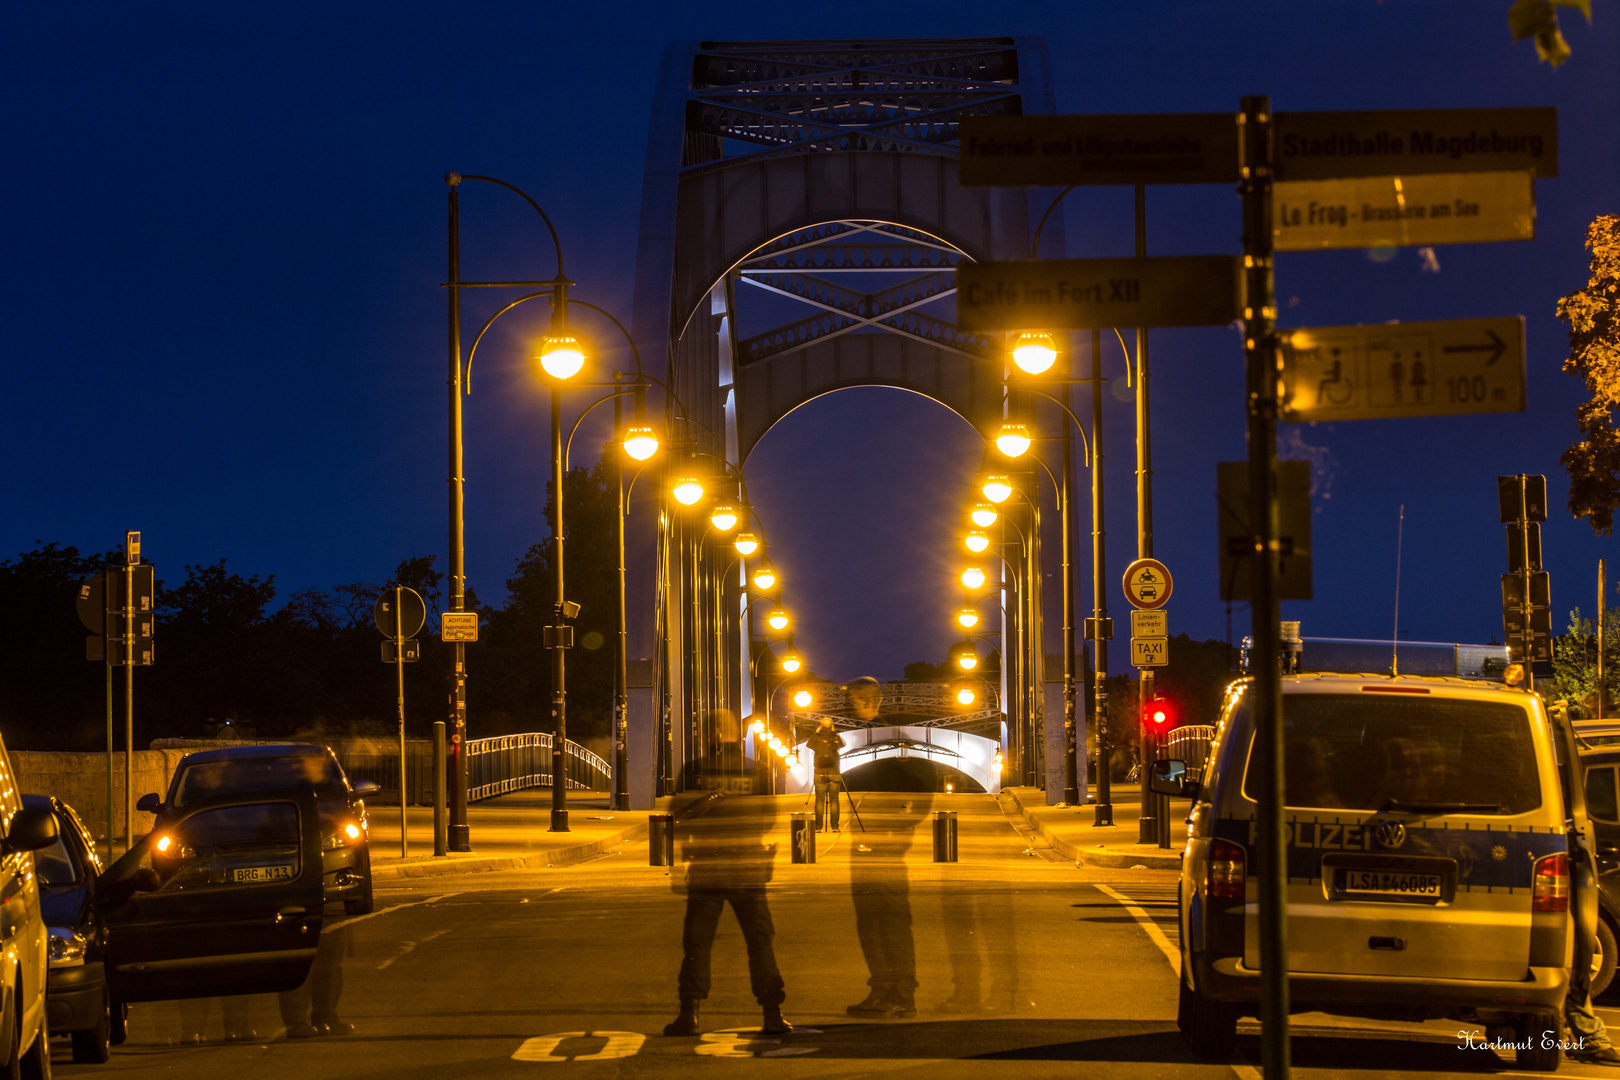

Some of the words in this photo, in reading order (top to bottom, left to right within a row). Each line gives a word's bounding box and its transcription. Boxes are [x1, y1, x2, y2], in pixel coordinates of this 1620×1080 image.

[1042, 137, 1071, 156] und
[1283, 131, 1403, 157] Stadthalle
[1410, 130, 1544, 160] Magdeburg
[1281, 203, 1302, 226] Le
[1308, 201, 1347, 227] Frog
[1430, 203, 1451, 219] am
[1454, 198, 1480, 217] See
[966, 280, 1017, 307] Café
[1023, 281, 1051, 304] im
[1057, 280, 1103, 304] Fort
[1108, 278, 1141, 303] XII
[1447, 375, 1486, 404] 100
[1492, 386, 1507, 402] m
[1137, 643, 1162, 654] TAXI
[237, 869, 259, 881] BRG
[1350, 873, 1380, 891] LSA
[1390, 874, 1438, 893] 46085
